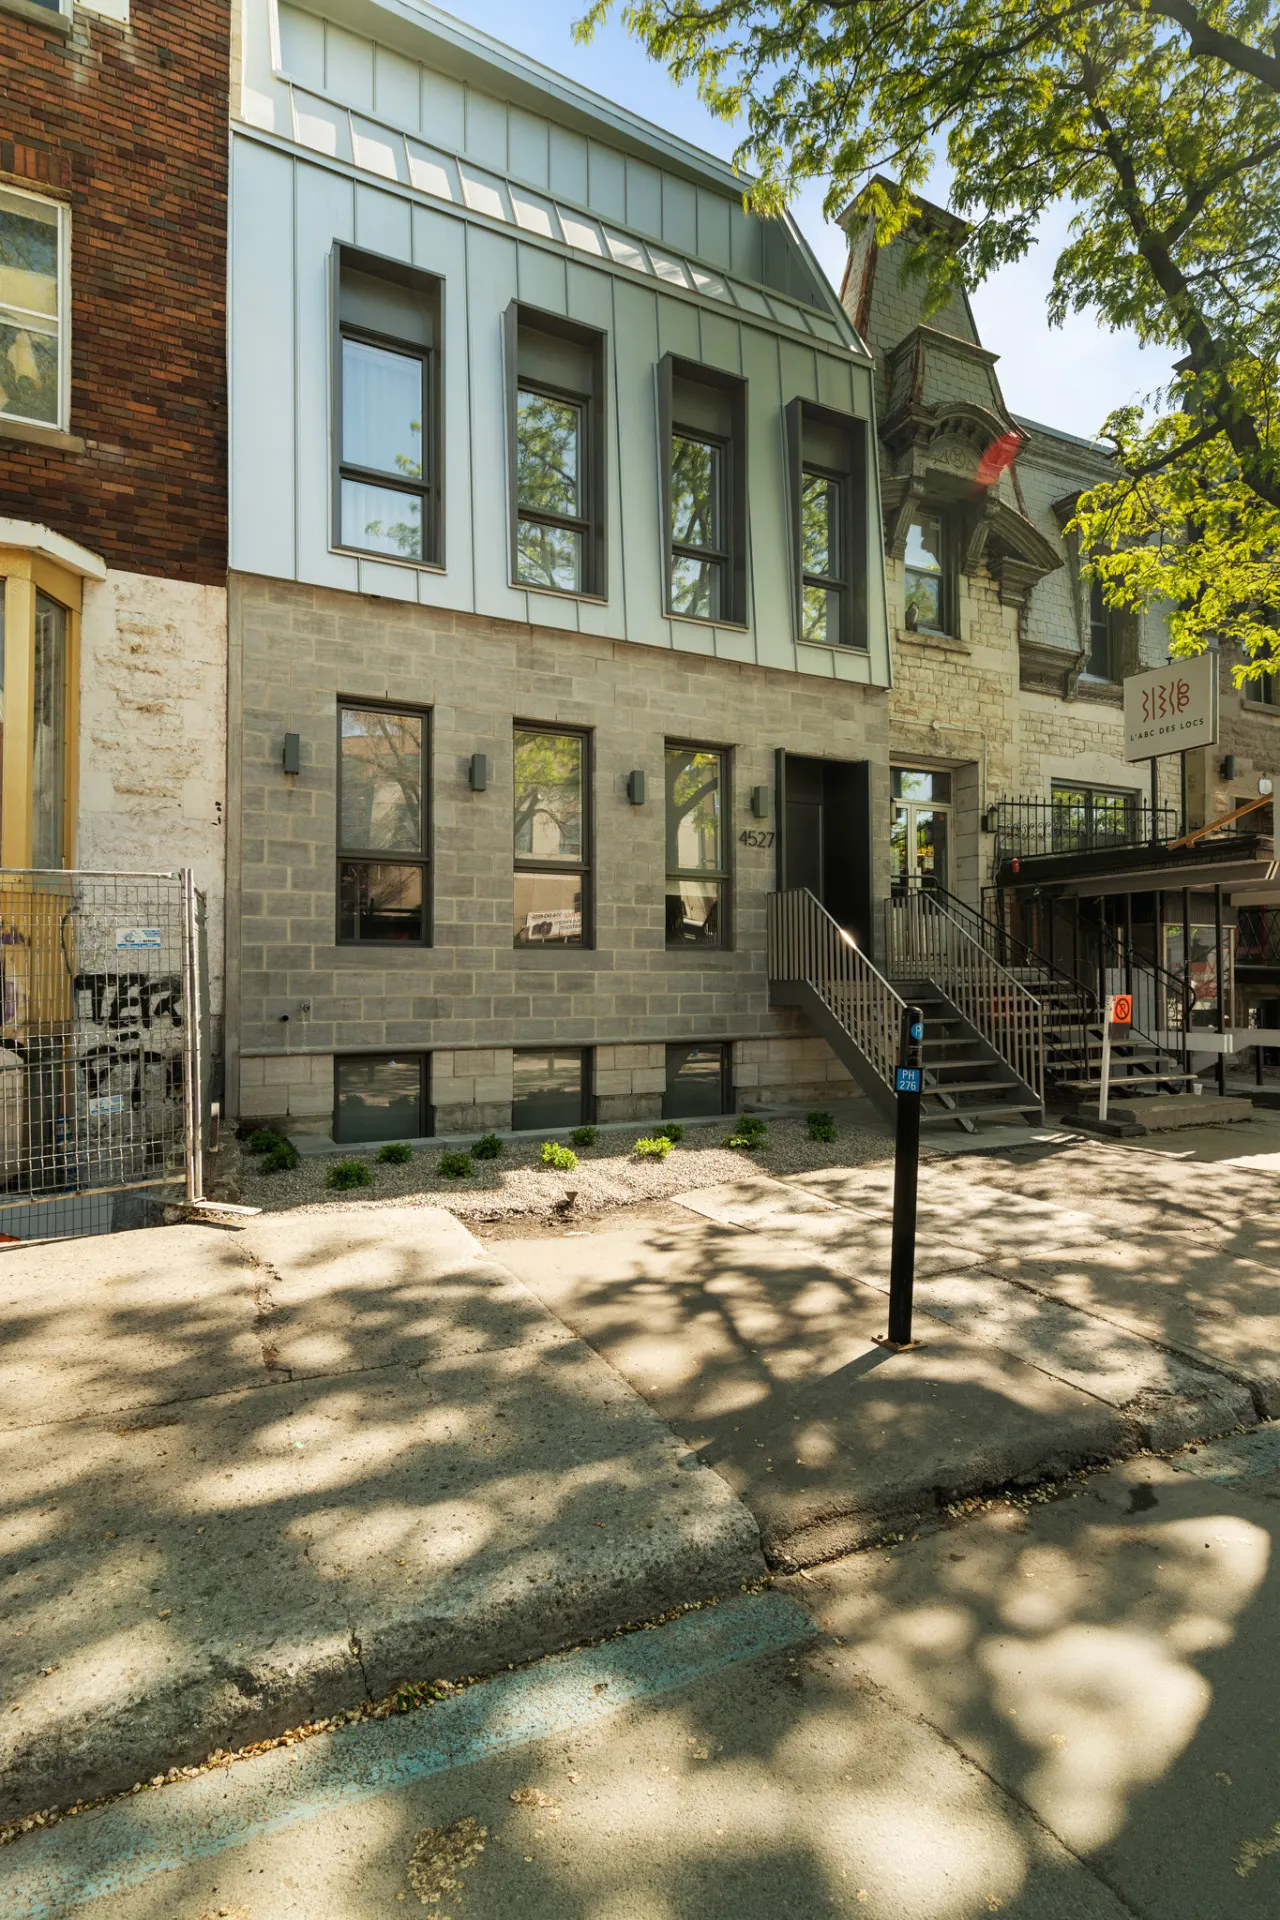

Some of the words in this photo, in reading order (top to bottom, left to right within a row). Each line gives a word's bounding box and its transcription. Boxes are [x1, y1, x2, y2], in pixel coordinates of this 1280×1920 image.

[1130, 729, 1155, 742] L'ABC
[1159, 724, 1176, 735] DES
[1180, 717, 1204, 730] LOCS
[738, 830, 776, 849] 4527
[902, 1069, 915, 1081] PH
[899, 1080, 917, 1091] 276
